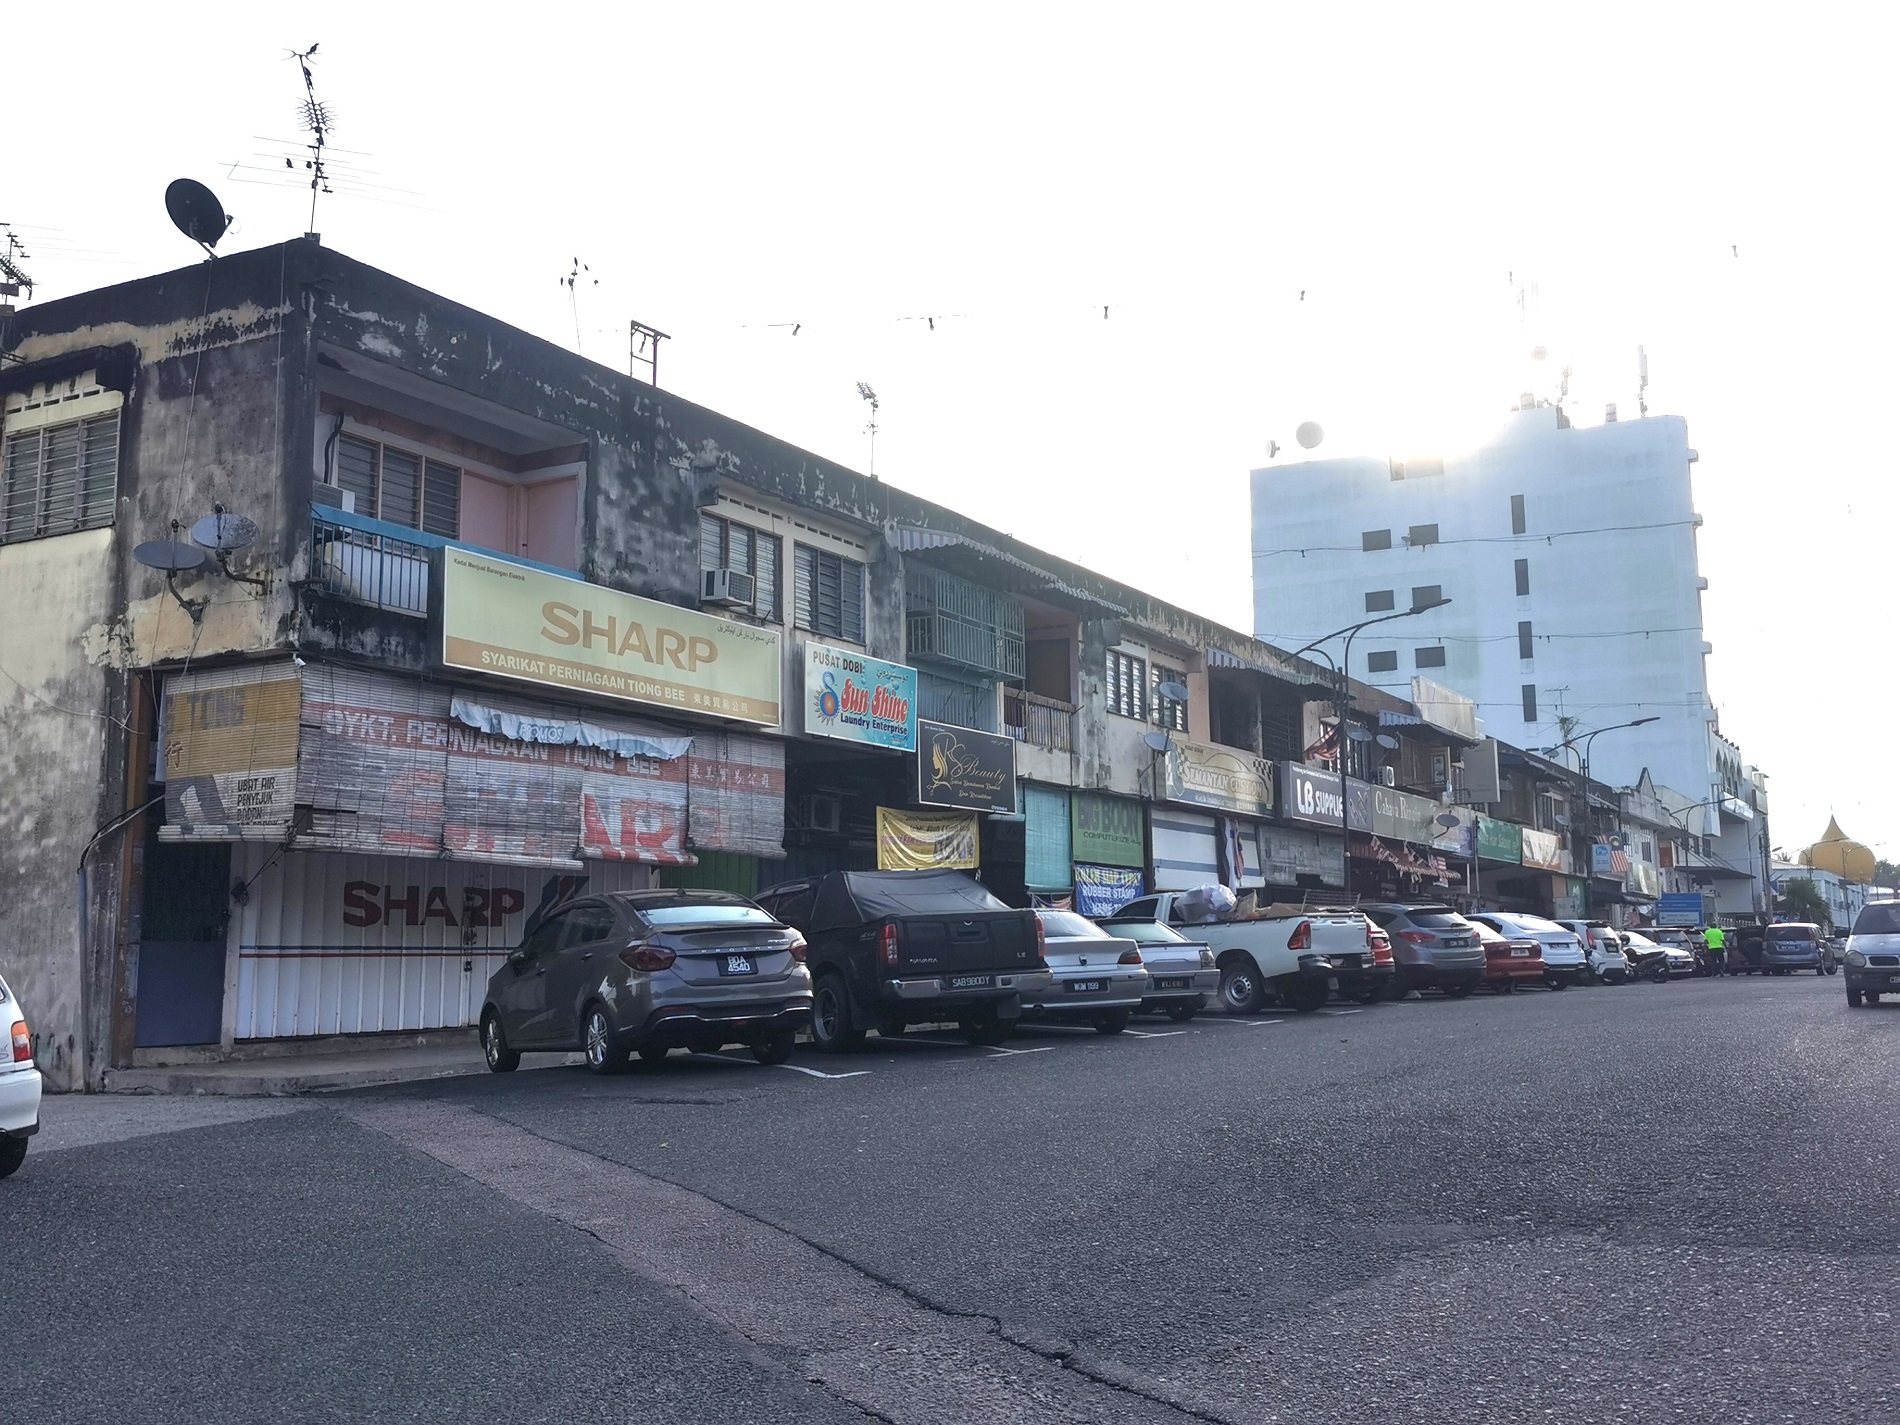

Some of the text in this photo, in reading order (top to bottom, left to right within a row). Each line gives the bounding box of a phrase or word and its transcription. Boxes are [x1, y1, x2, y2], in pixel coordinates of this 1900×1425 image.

[540, 601, 718, 673] SHARP
[481, 651, 685, 702] SYARIKAT PERNIAGAAN TIONG BEE
[813, 651, 863, 675] PUSAT DOBI
[841, 678, 908, 724] Sun Shine
[406, 719, 549, 760] PERNIAGAAN
[841, 713, 870, 730] Laundry
[872, 719, 908, 735] Enterprise
[237, 777, 275, 793] UBAT AIR
[961, 754, 1006, 785] Beauty
[343, 880, 525, 927] SHARP
[728, 963, 751, 972] 4540
